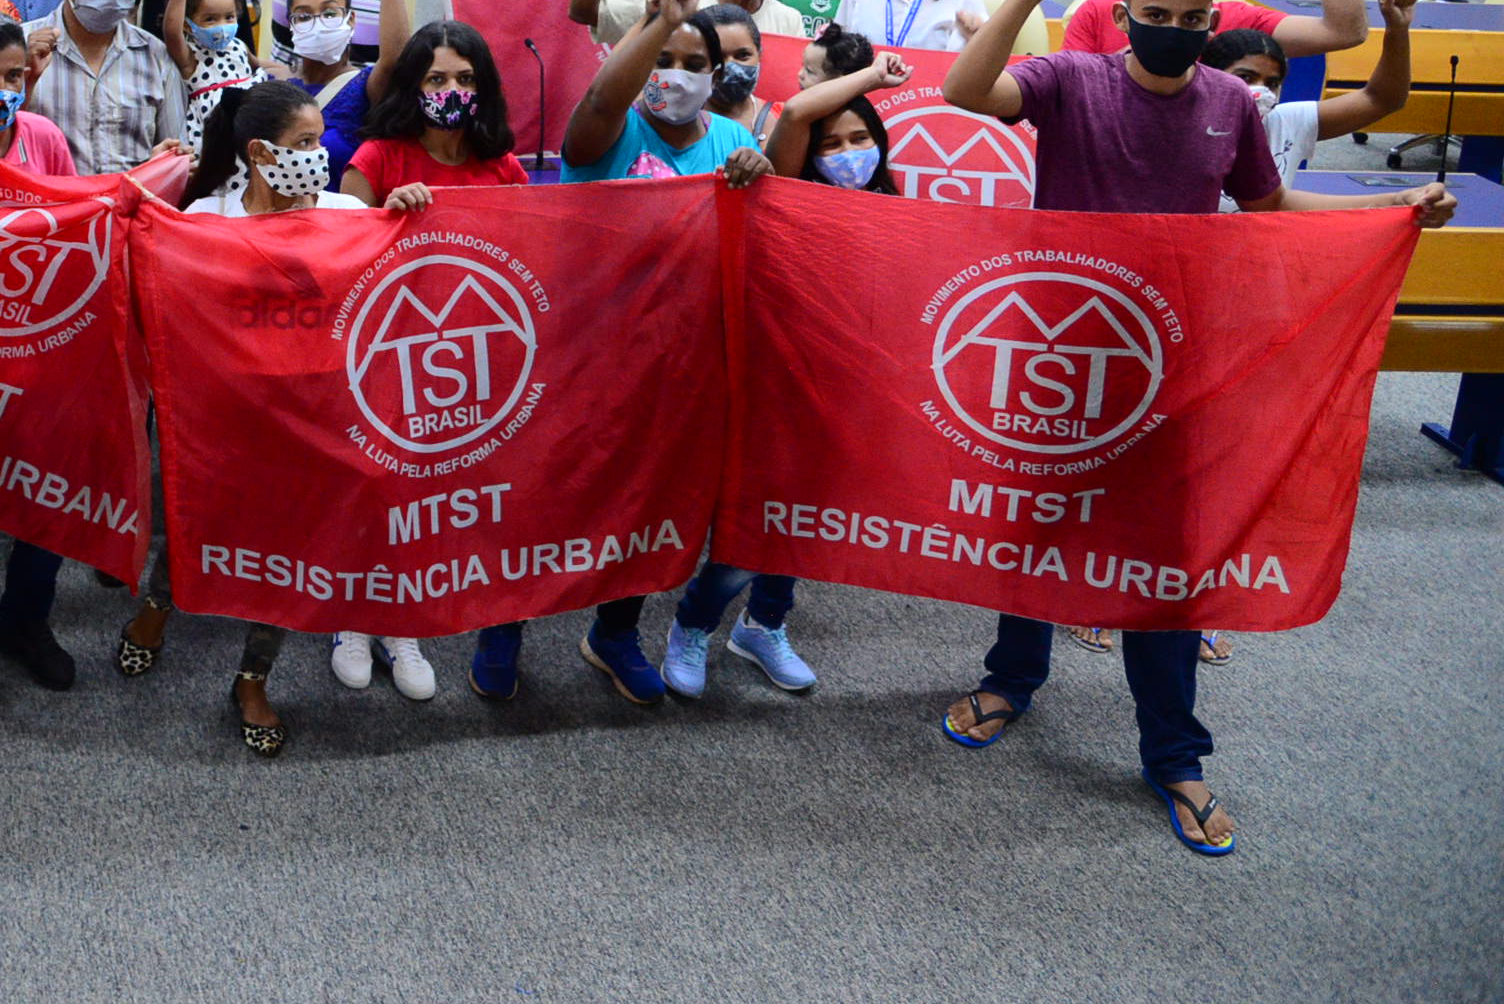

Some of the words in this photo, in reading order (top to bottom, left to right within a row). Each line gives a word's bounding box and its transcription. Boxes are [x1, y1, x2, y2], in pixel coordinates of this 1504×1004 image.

[891, 90, 917, 106] DOS
[16, 189, 42, 205] DOS
[331, 267, 375, 341] MOVIMENTO
[374, 247, 396, 271] DOS
[395, 230, 510, 263] TRABALHADORES
[507, 257, 533, 284] SEM
[529, 277, 551, 314] TETO
[920, 265, 981, 325] MOVIMENTO
[980, 253, 1013, 272] DOS
[1014, 249, 1144, 289] TRABALHADORES
[1141, 283, 1169, 311] SEM
[1161, 307, 1185, 344] TETO
[37, 310, 98, 354] URBANA
[346, 424, 368, 450] NA
[365, 443, 398, 474] LUTA
[399, 462, 432, 479] PELA
[434, 437, 503, 477] REFORMA
[499, 382, 547, 441] URBANA
[408, 404, 491, 439] BRASIL
[919, 399, 941, 423] NA
[934, 419, 971, 453] LUTA
[971, 446, 1015, 472] PELA
[1018, 456, 1107, 476] REFORMA
[1105, 411, 1168, 461] URBANA
[992, 411, 1096, 441] BRASIL
[387, 482, 513, 546] MTST
[947, 478, 1105, 524] MTST
[200, 544, 490, 604] RESISTÊNCIA
[499, 518, 685, 582] URBANA
[763, 500, 1071, 582] RESISTÊNCIA
[1084, 552, 1291, 602] URBANA
